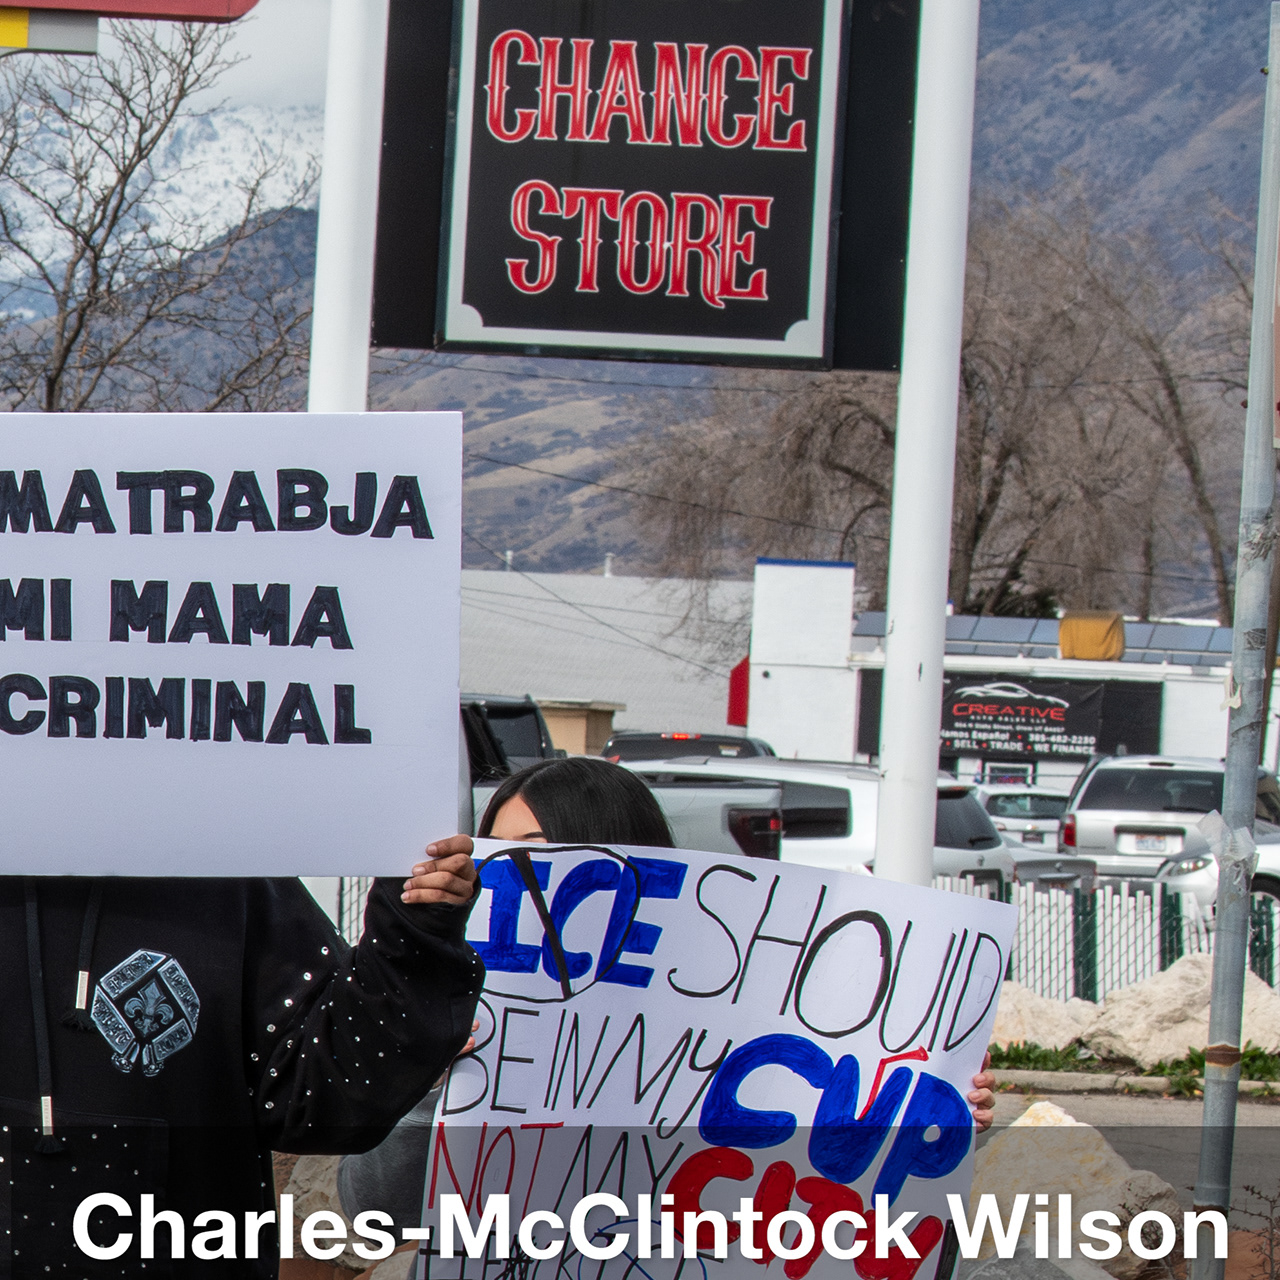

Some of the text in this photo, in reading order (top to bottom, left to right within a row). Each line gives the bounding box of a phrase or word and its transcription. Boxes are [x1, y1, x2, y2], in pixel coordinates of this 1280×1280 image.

[483, 29, 813, 152] CHANCE
[505, 179, 774, 309] STORE
[109, 579, 354, 651] MAMA
[951, 702, 1066, 722] CREATIVE
[953, 739, 1097, 756] SELL TRADE WE FINANCE
[467, 854, 689, 989] ICE
[441, 996, 541, 1116] BE
[587, 1012, 734, 1140] MY
[698, 1032, 973, 1210] CUP
[428, 1121, 565, 1218] NOT
